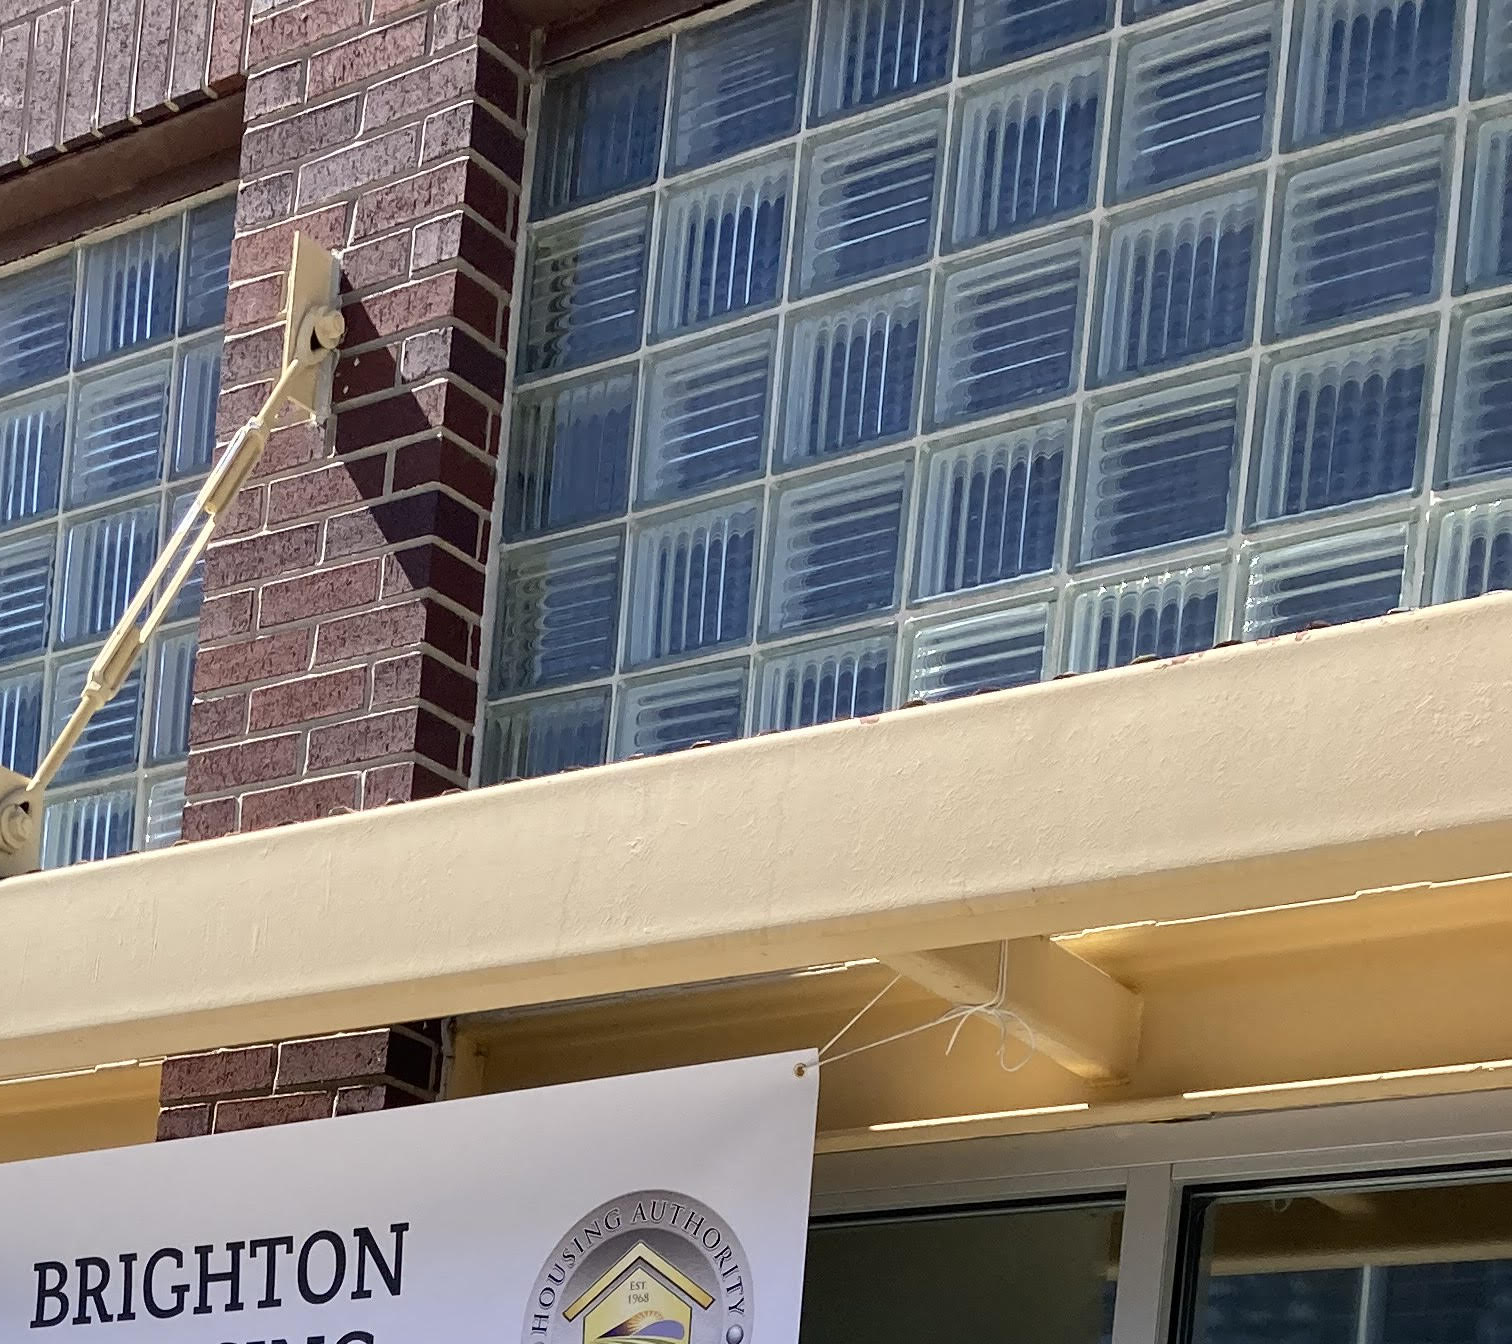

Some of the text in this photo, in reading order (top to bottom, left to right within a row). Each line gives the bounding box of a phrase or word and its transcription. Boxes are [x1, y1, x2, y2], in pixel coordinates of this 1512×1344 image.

[29, 1222, 410, 1329] BRIGHTON
[531, 1200, 745, 1334] HOUSING AUTHORITY
[627, 1292, 650, 1304] 1968
